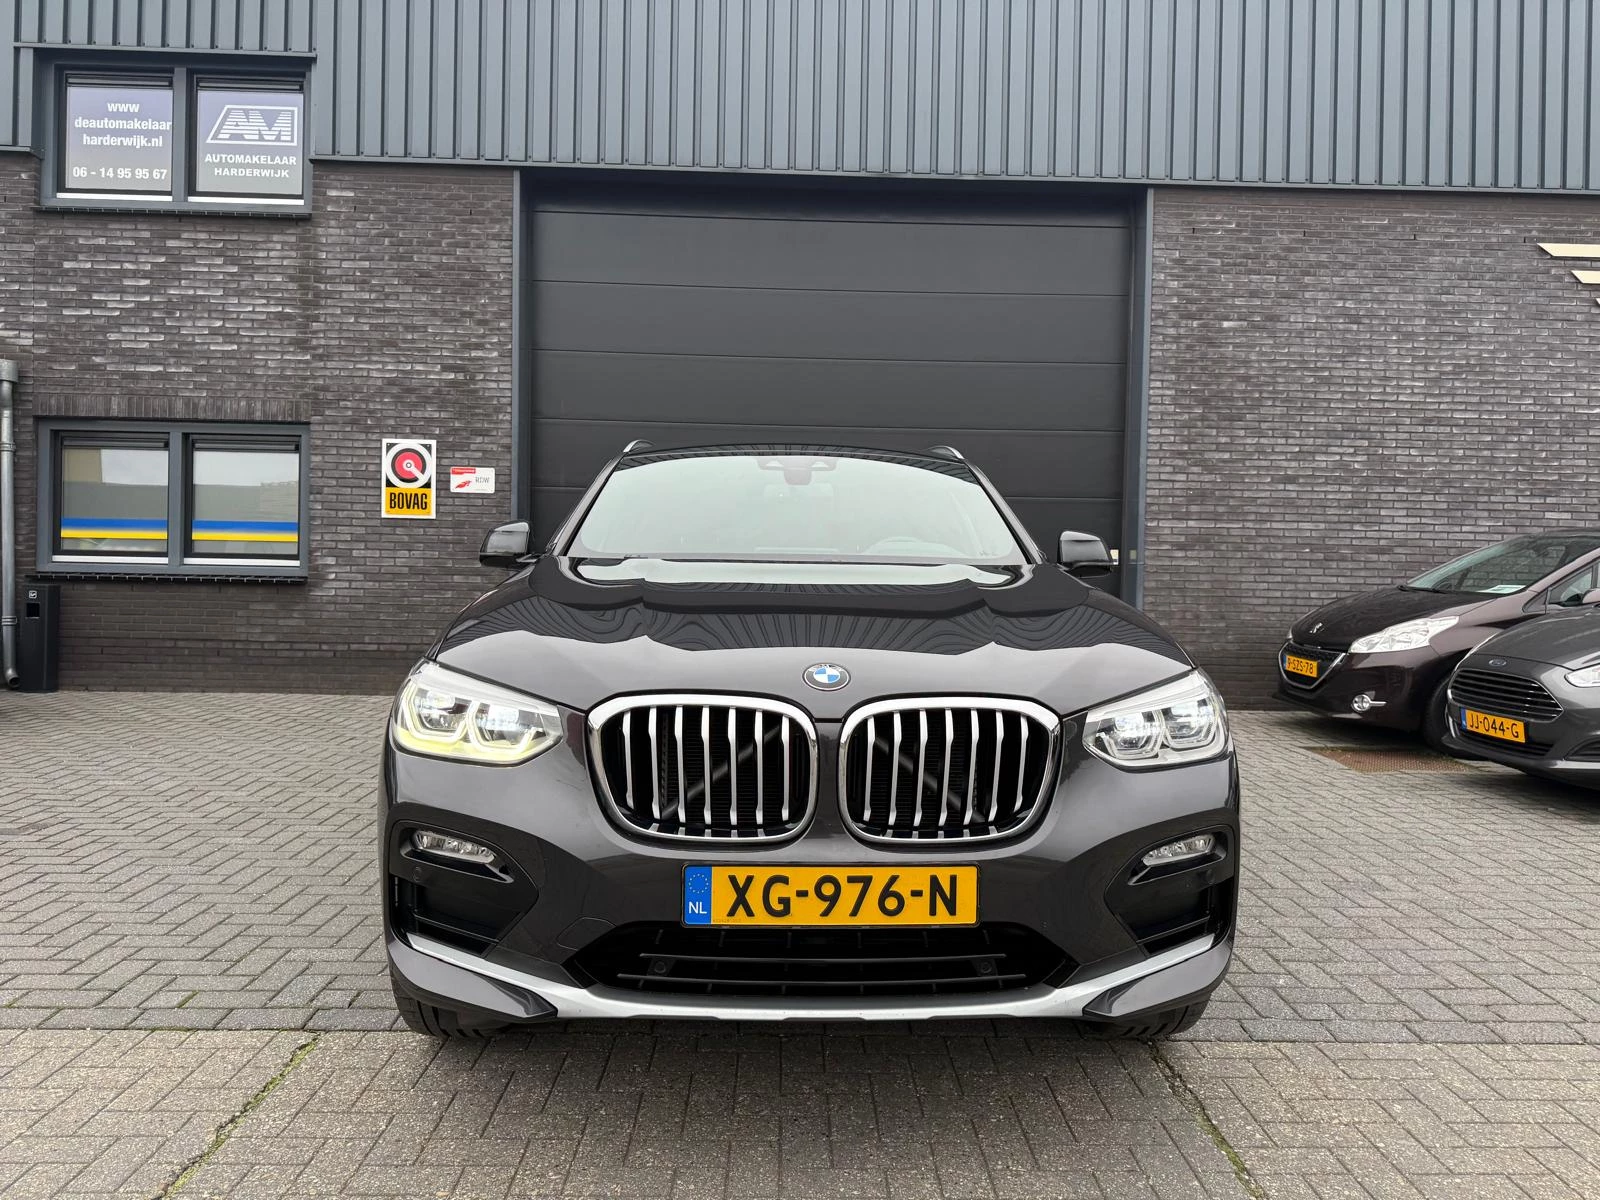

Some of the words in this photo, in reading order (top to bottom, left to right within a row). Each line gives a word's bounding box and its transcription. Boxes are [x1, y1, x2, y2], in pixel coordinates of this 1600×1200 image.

[107, 102, 140, 113] www
[74, 117, 172, 131] deautomakelaar
[83, 133, 163, 149] harderwijk.nl
[204, 153, 297, 166] AUTOMAKELAAR
[72, 166, 87, 178] 06
[99, 167, 114, 179] 14
[117, 167, 131, 179] 95
[135, 168, 150, 180] 95
[153, 168, 168, 180] 67
[214, 166, 290, 179] HARDERWIJK
[389, 491, 428, 510] BOVAG
[1470, 712, 1520, 739] JJ-044-G
[726, 874, 958, 918] XG-976-N
[688, 901, 708, 914] NL
